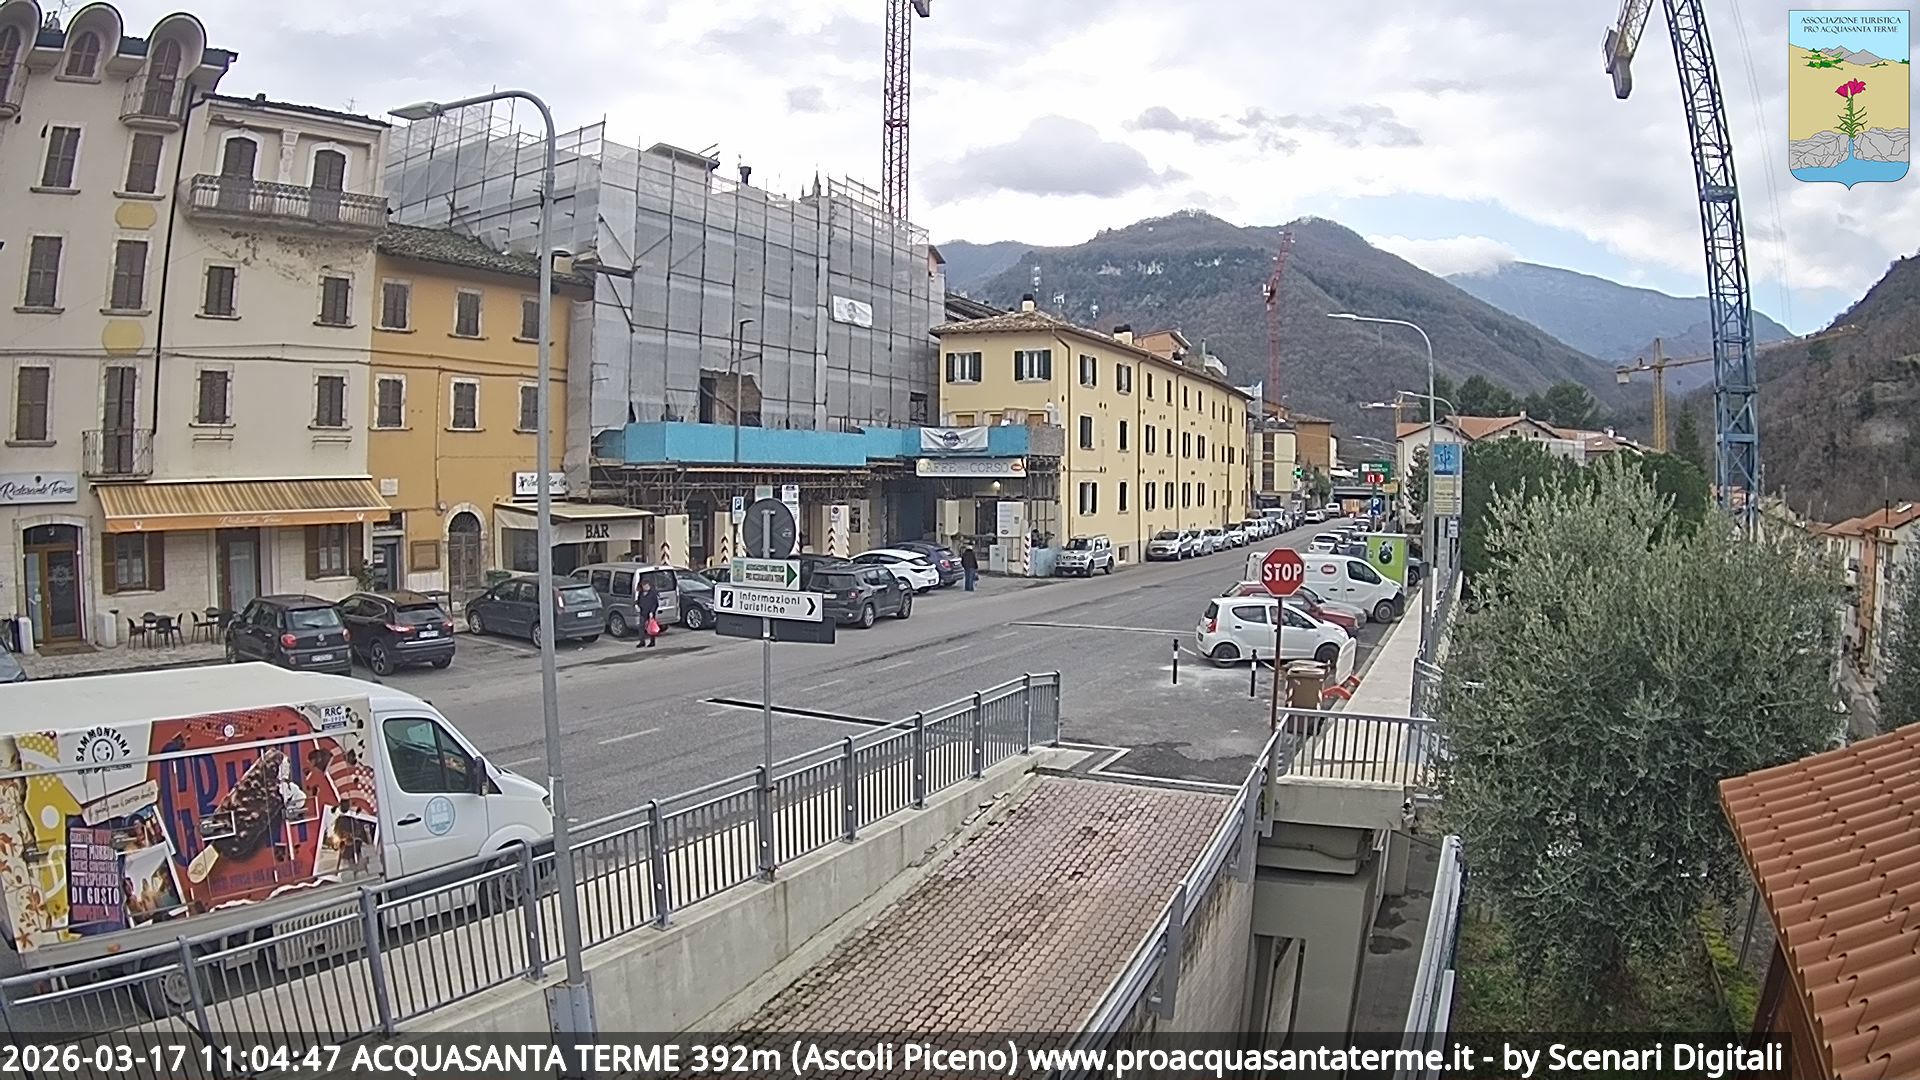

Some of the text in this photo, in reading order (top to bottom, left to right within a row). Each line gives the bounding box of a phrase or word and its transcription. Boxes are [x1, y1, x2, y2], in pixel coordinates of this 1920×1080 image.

[969, 462, 1009, 473] CORSO
[1373, 498, 1380, 507] P
[585, 523, 610, 539] BAR
[1263, 563, 1302, 581] STOP
[739, 592, 800, 605] Informazioni
[739, 601, 786, 614] Turistiche
[325, 706, 342, 717] RRC
[75, 727, 131, 762] SAMMONTANA
[72, 886, 120, 905] DI GUSTO
